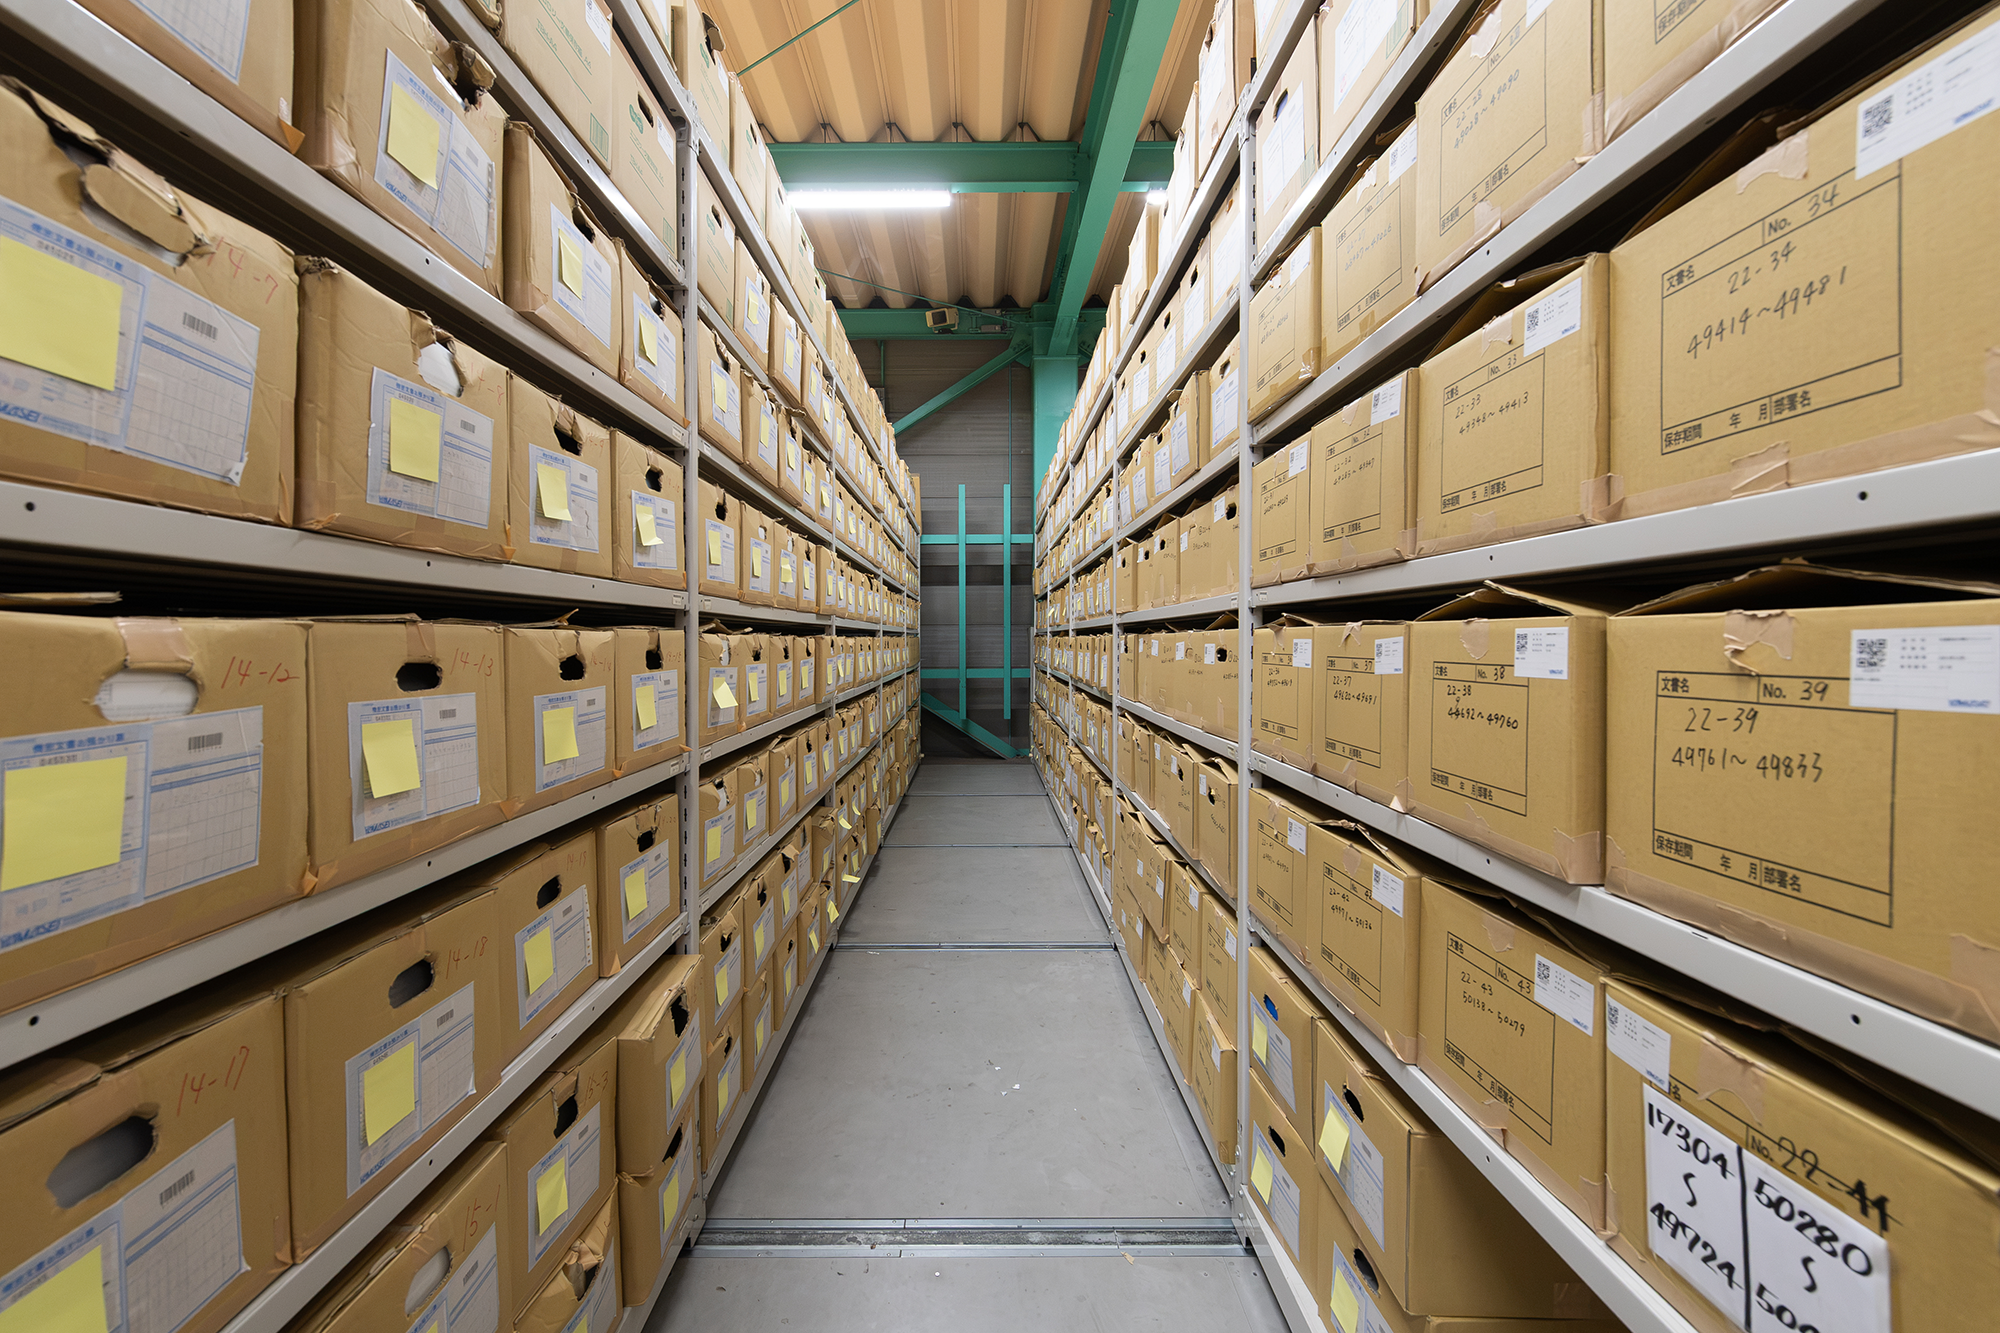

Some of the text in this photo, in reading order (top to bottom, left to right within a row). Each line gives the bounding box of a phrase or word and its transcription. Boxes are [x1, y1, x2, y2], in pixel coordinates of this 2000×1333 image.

[1767, 184, 1841, 237] No. 34
[207, 237, 279, 305] 14-7
[1666, 264, 1695, 292] 文書名
[1728, 241, 1797, 295] 22-34
[1687, 266, 1848, 360] 49414~49481
[1490, 354, 1518, 377] No. 33
[1455, 394, 1481, 419] 22-33
[1773, 390, 1812, 416] 部署名
[1664, 423, 1703, 449] 保存期間
[221, 656, 300, 689] 14-12
[450, 648, 494, 677] 14-13
[1364, 660, 1373, 671] 37
[1494, 666, 1506, 681] 38
[1333, 675, 1352, 686] 22-37
[1447, 684, 1472, 696] 22-38
[1661, 677, 1690, 694] 文書名
[1763, 681, 1829, 701] No. 39
[1685, 707, 1759, 734] 22-39
[1655, 836, 1693, 860] 保存期間
[1763, 866, 1802, 893] 部署名
[446, 936, 488, 980] 14-18
[1460, 971, 1494, 996] 22-43
[1498, 967, 1532, 994] No. 43
[177, 1046, 249, 1116] 14-17
[1647, 1102, 1736, 1180] 17304
[1751, 1135, 1774, 1162] No.
[1753, 1177, 1873, 1277] 50280
[1650, 1202, 1745, 1291] 49724
